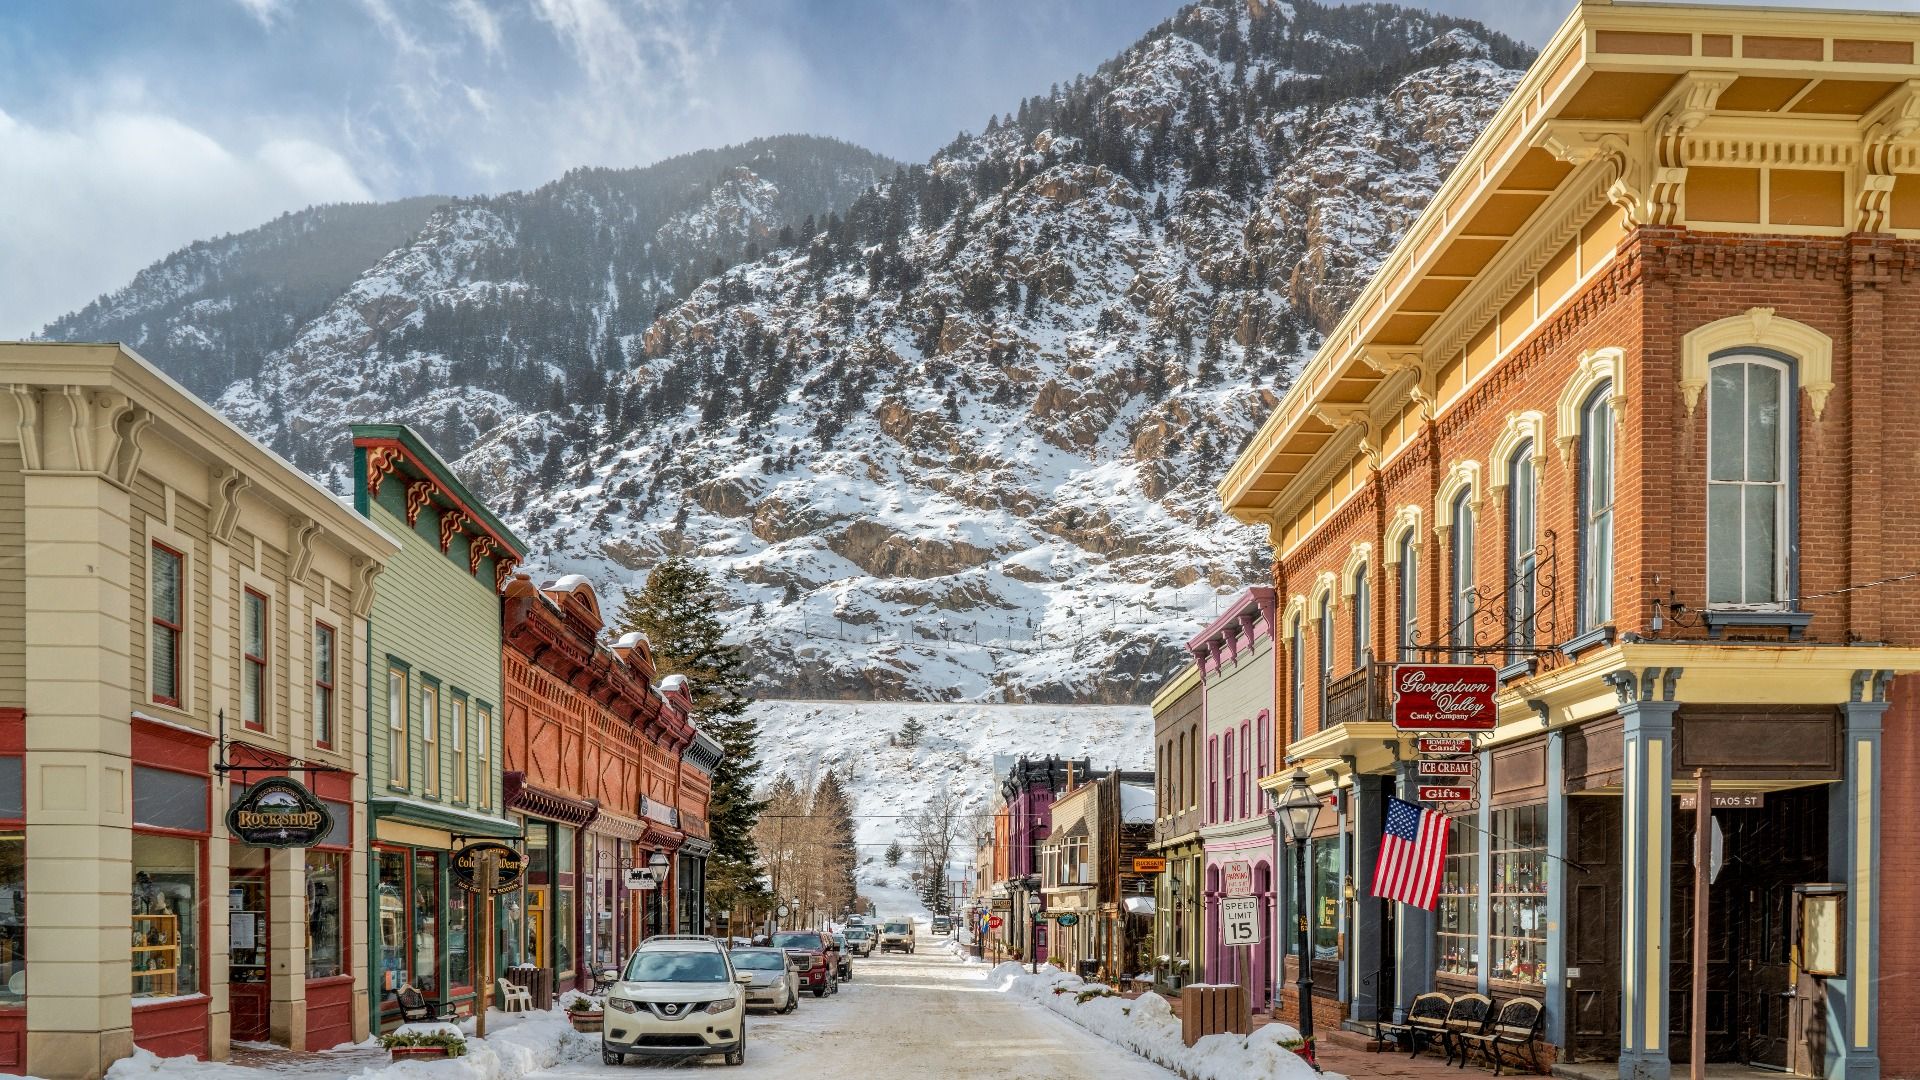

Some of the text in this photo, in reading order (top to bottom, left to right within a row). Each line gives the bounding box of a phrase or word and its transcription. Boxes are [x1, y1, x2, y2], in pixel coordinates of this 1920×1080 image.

[1401, 670, 1490, 700] Georgetown
[1436, 693, 1486, 717] Valley
[1410, 711, 1469, 721] Candy Company
[1428, 744, 1462, 752] Candy
[1421, 762, 1469, 773] ICE CREAM
[1425, 788, 1461, 799] Gifts
[1713, 796, 1758, 806] TAOS ST
[1231, 864, 1241, 872] NO
[1225, 901, 1255, 910] SPEED
[1228, 911, 1252, 920] LIMIT
[1230, 921, 1253, 940] 15
